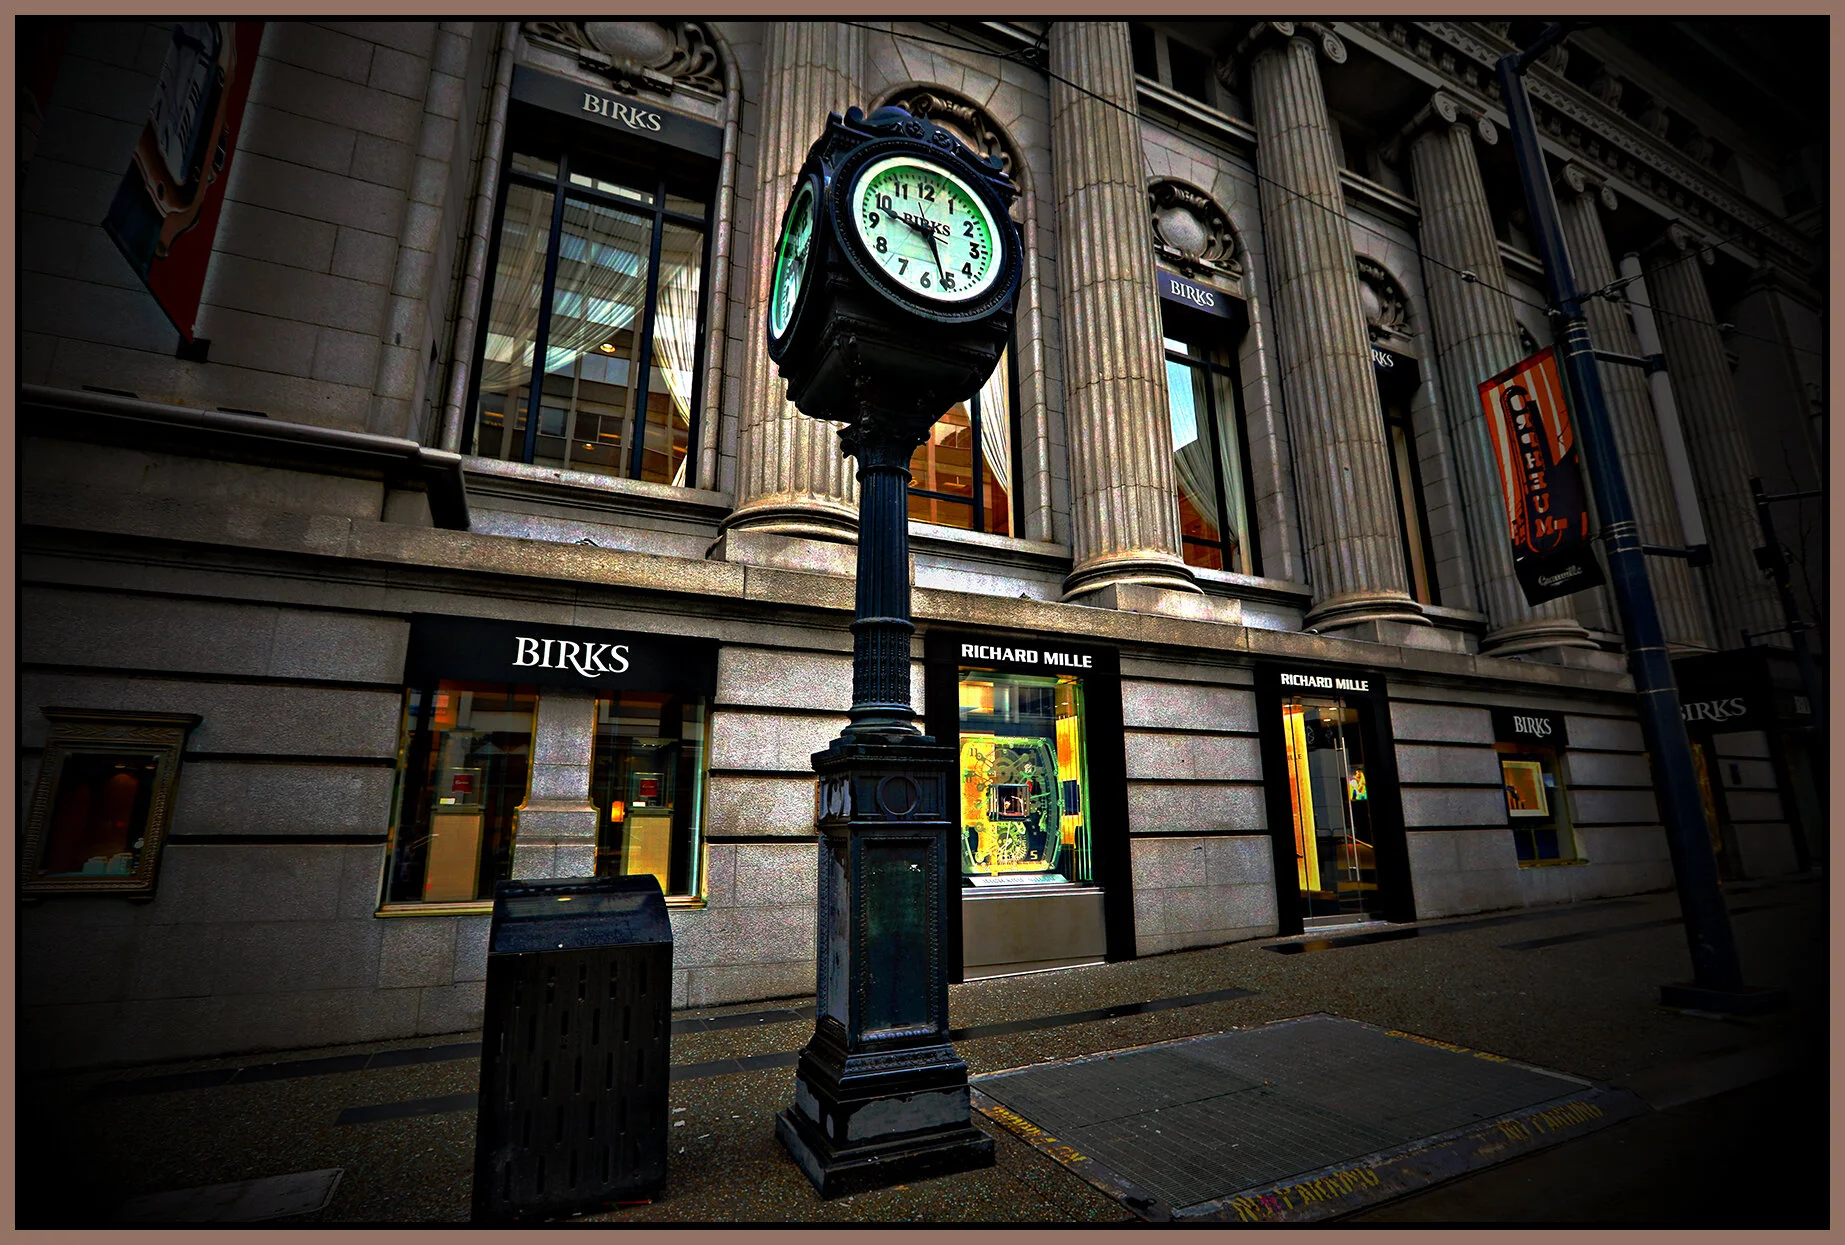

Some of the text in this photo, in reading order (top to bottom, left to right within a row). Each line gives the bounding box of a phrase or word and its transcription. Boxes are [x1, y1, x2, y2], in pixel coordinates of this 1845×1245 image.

[582, 92, 662, 132] BIRKS
[894, 181, 909, 201] 11
[918, 182, 935, 202] 12
[876, 192, 893, 212] 10
[948, 198, 955, 215] 1
[868, 211, 881, 229] 9
[963, 220, 974, 238] 2
[875, 236, 888, 254] 8
[968, 241, 981, 260] 3
[897, 257, 910, 276] 7
[961, 261, 974, 280] 4
[919, 271, 932, 289] 6
[1169, 279, 1215, 307] BIRKS
[1371, 348, 1395, 368] RKS
[511, 636, 630, 679] BIRKS
[961, 643, 1093, 669] RICHARD MILLE
[1280, 673, 1370, 692] RICHARD MILLE
[1512, 715, 1552, 738] BIRKS
